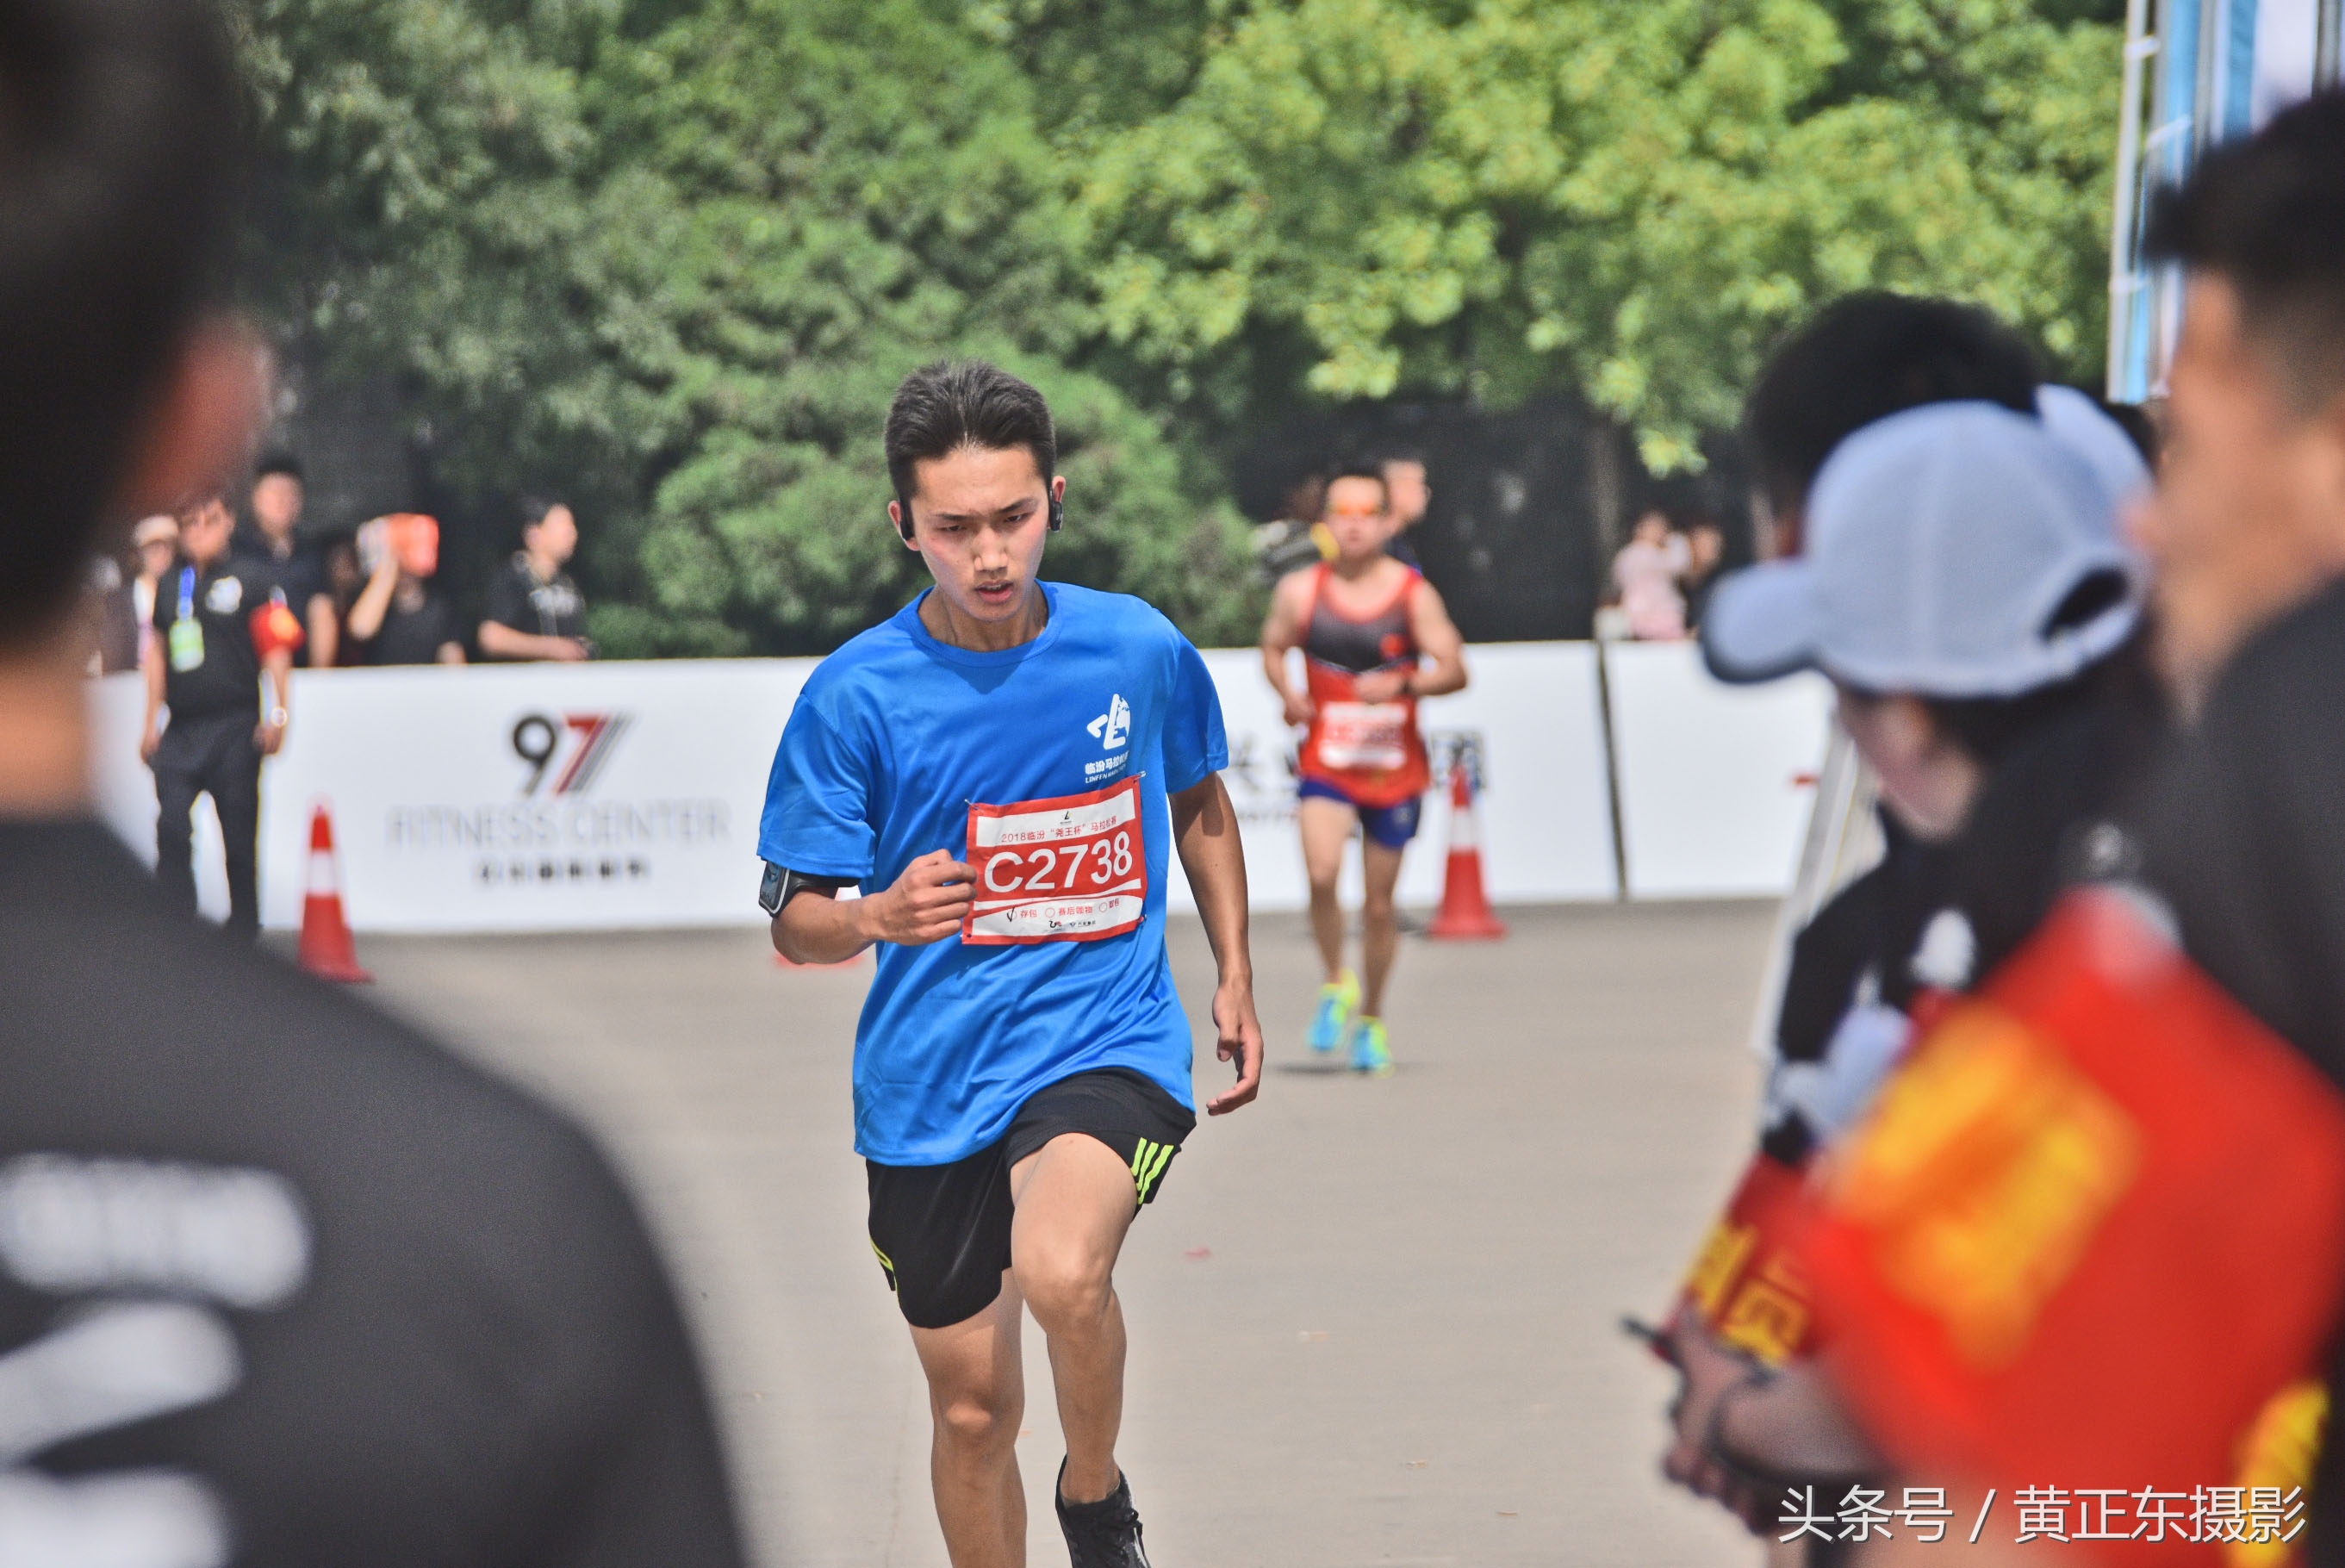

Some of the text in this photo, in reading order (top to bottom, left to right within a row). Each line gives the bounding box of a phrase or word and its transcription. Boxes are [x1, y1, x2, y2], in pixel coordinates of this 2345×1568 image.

[512, 712, 636, 797] 97
[387, 800, 730, 847] FITNESS CENTER
[984, 831, 1133, 893] C2738
